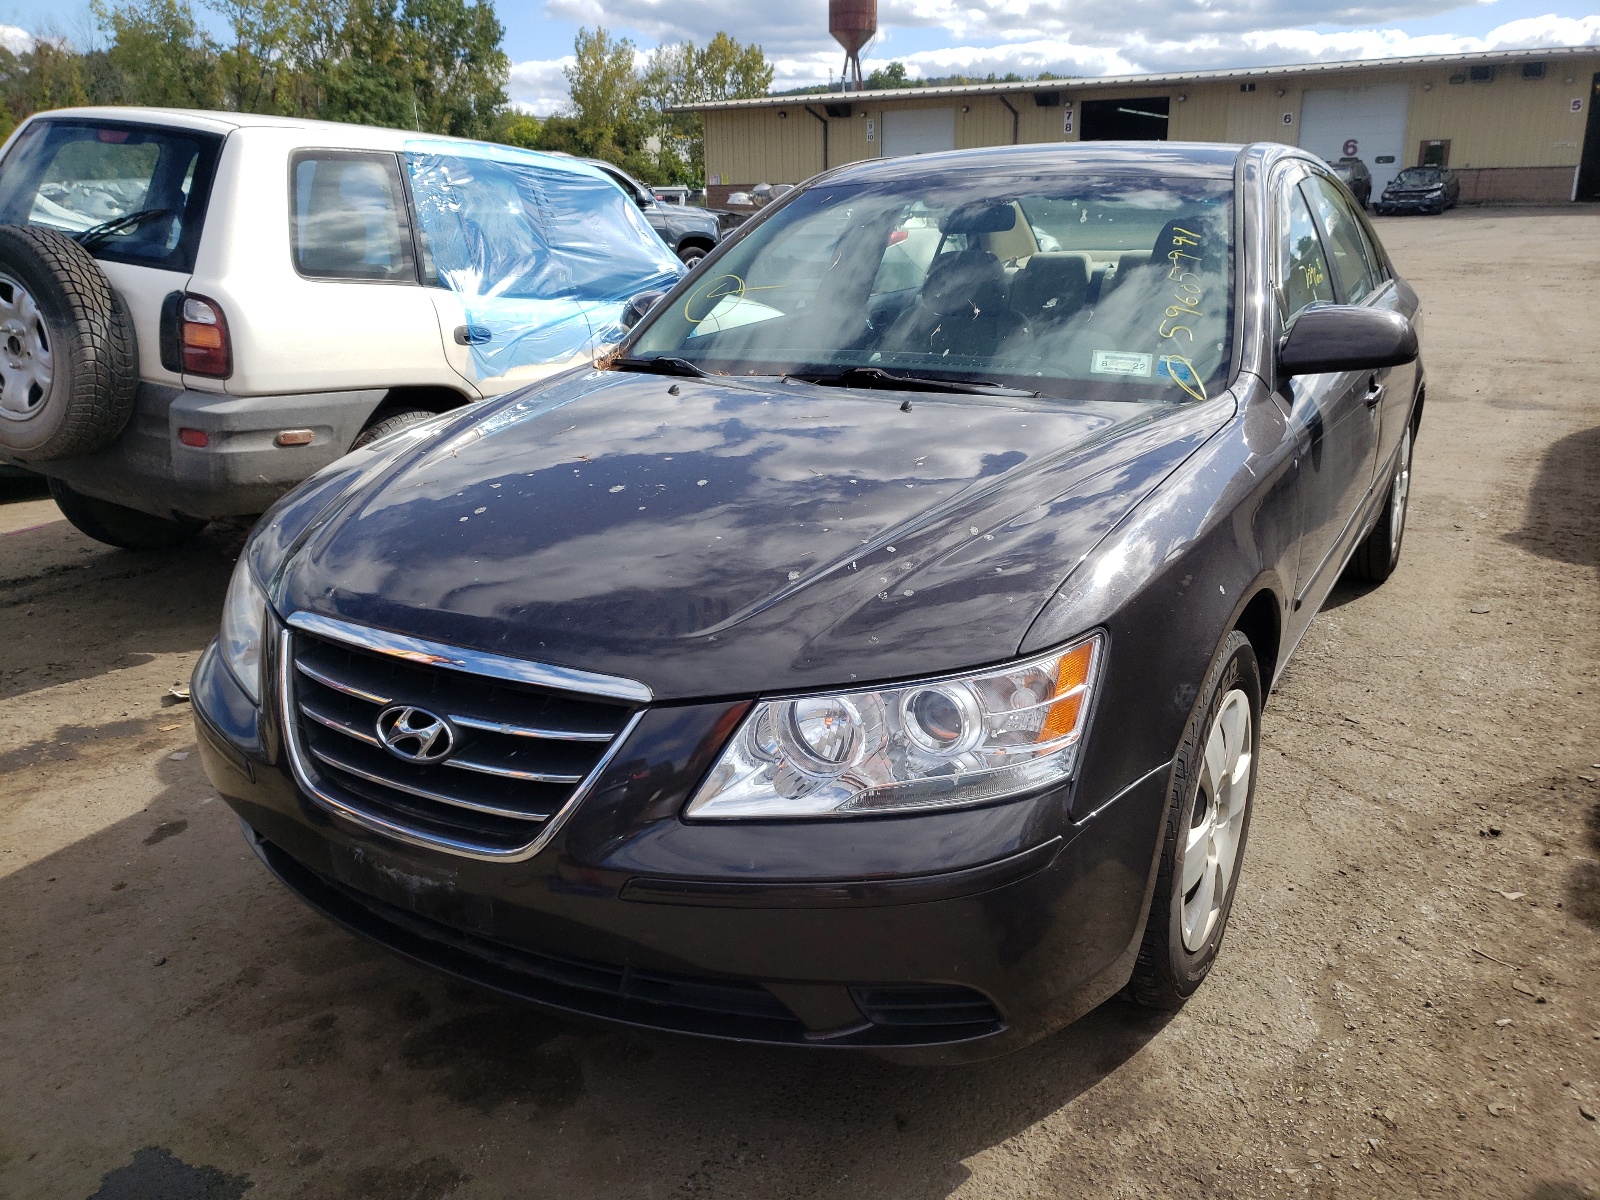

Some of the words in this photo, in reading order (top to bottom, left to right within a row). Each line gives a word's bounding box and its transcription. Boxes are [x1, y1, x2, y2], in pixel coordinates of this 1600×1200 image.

[1571, 100, 1580, 110] 5
[1065, 111, 1072, 120] 7
[1283, 114, 1292, 123] 6
[1065, 123, 1072, 132] 8
[1342, 138, 1359, 157] 6
[1132, 362, 1146, 371] 22
